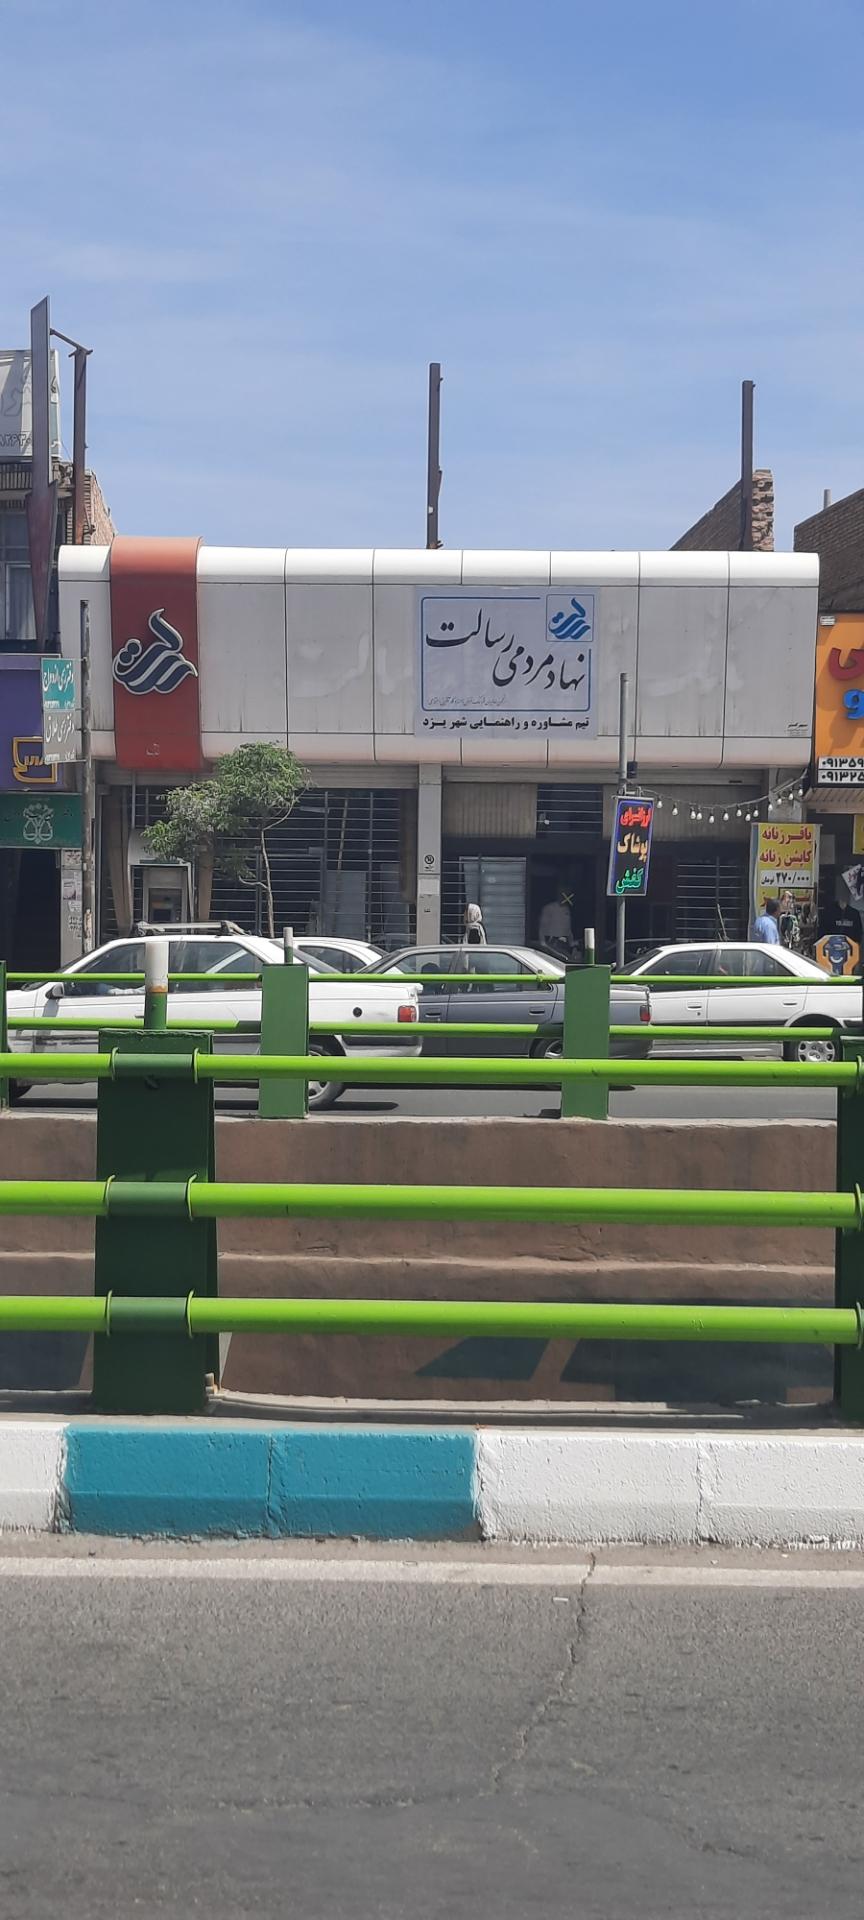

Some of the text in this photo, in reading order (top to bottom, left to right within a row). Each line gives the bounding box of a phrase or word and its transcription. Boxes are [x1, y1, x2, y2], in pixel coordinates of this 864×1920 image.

[425, 608, 515, 653] رسالت
[492, 646, 554, 687] مردمی
[543, 653, 585, 690] نهاد
[422, 716, 589, 731] تیم مشاوره و راهنمایی شهر یزد
[617, 832, 649, 863] پوشاک
[761, 826, 785, 845] زنانه
[760, 848, 812, 867] کاپشن زنانه
[615, 867, 644, 894] کفش
